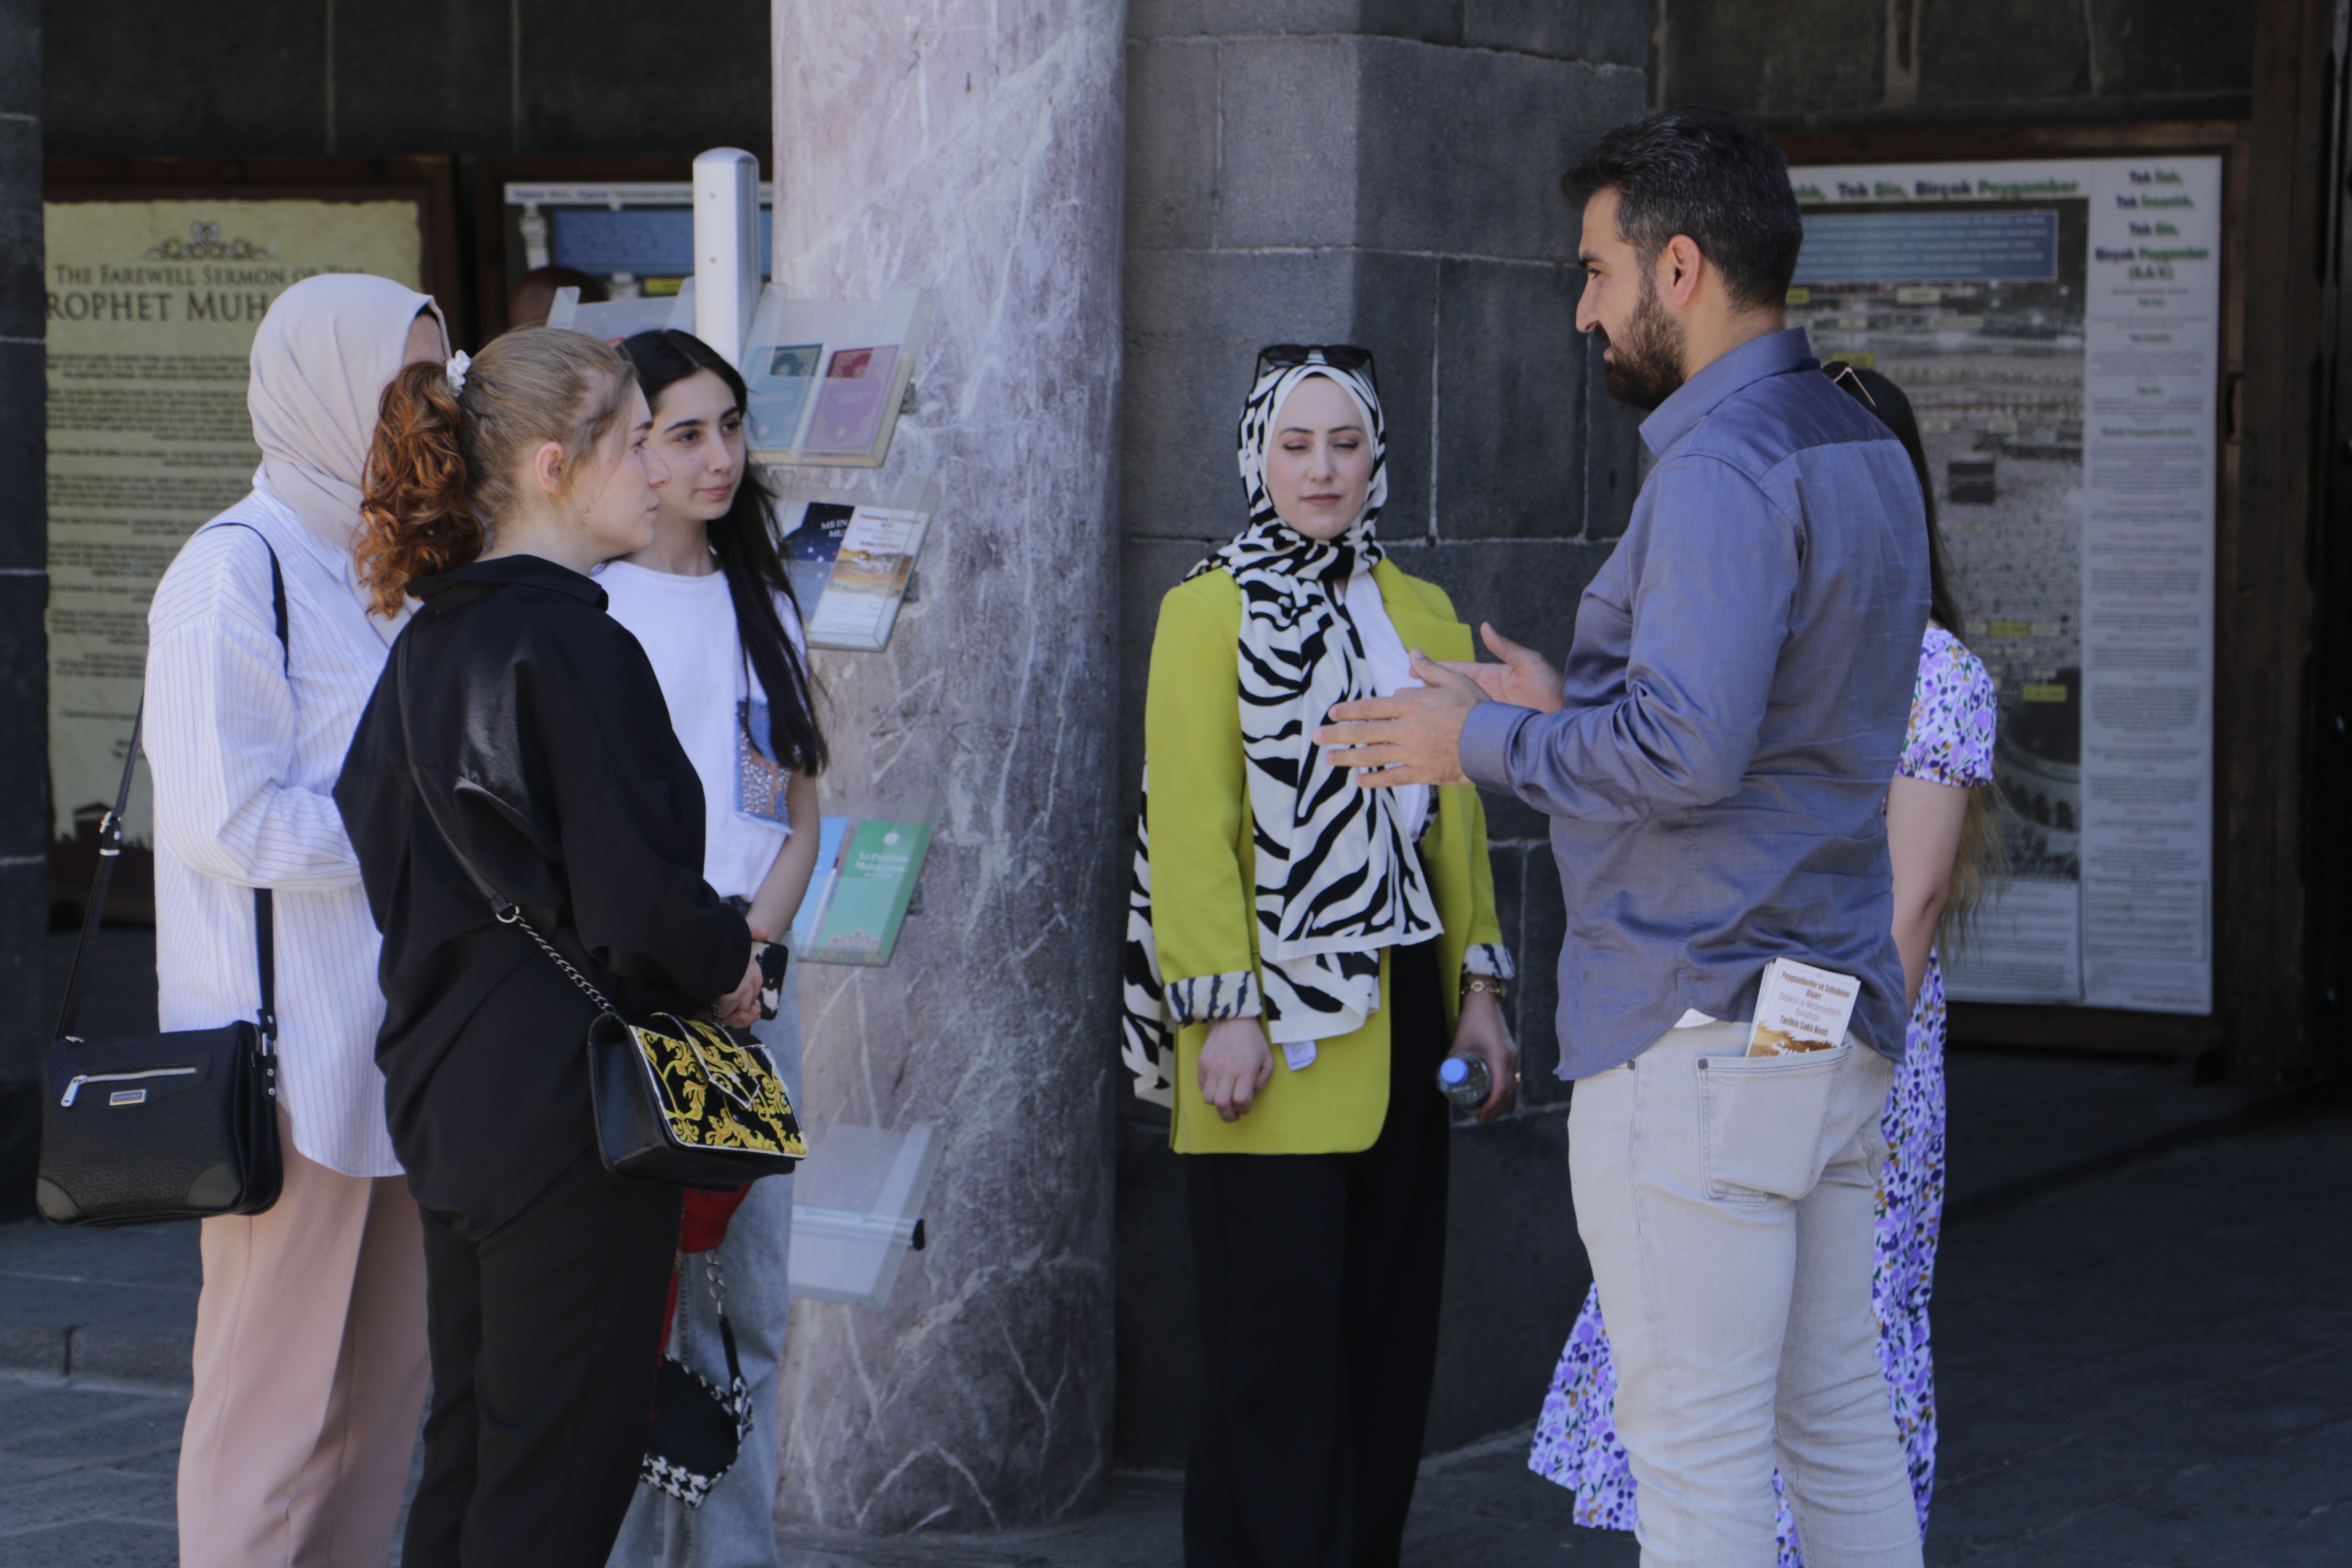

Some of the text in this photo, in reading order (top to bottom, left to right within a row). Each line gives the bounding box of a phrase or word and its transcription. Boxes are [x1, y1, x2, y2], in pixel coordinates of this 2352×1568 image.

[55, 264, 92, 285] THE
[100, 263, 195, 286] FAREWELL
[203, 265, 284, 287] SERMON
[45, 291, 268, 323] ROPHET MUH
[1781, 971, 1818, 989] Peygamberler
[1825, 984, 1850, 999] Sahabeler
[1778, 992, 1798, 1004] Dinlerin
[1780, 1015, 1829, 1037] Tarihin Saklı Kenti
